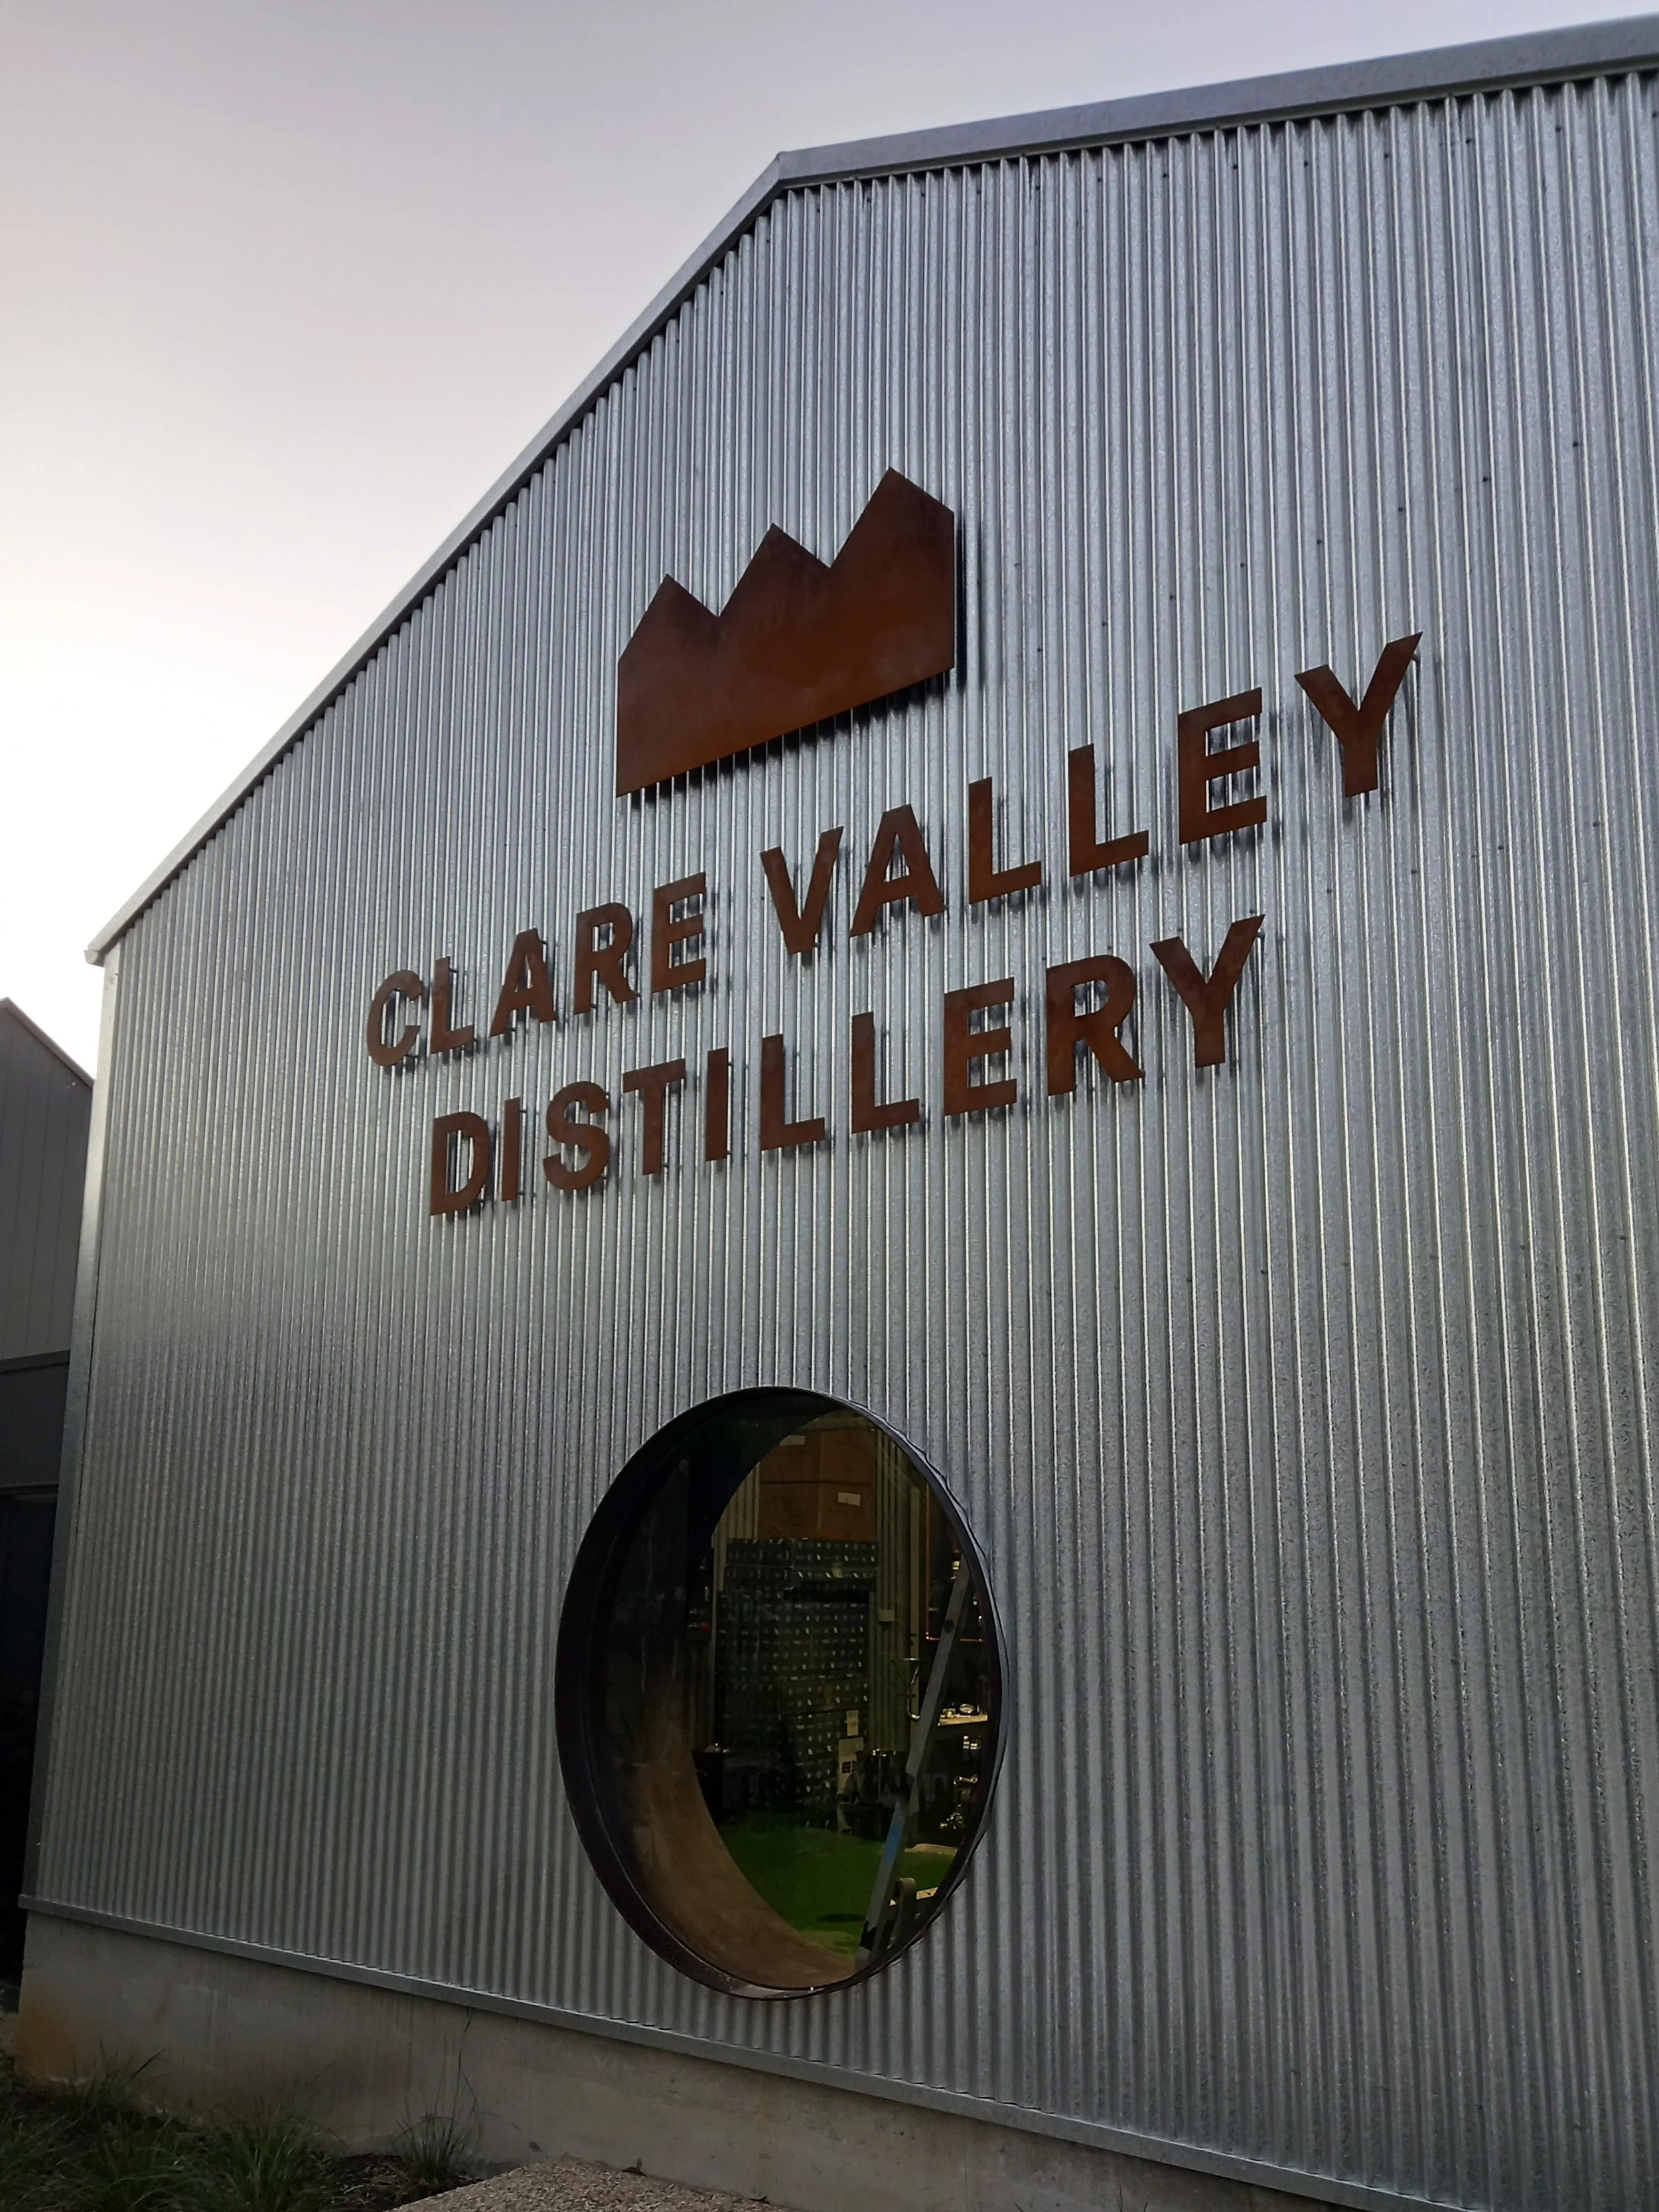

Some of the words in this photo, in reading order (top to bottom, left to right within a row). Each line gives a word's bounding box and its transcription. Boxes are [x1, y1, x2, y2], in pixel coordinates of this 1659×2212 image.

[366, 871, 706, 1066] CLARE
[760, 631, 1423, 954] VALLEY
[430, 915, 1265, 1216] DISTILLERY
